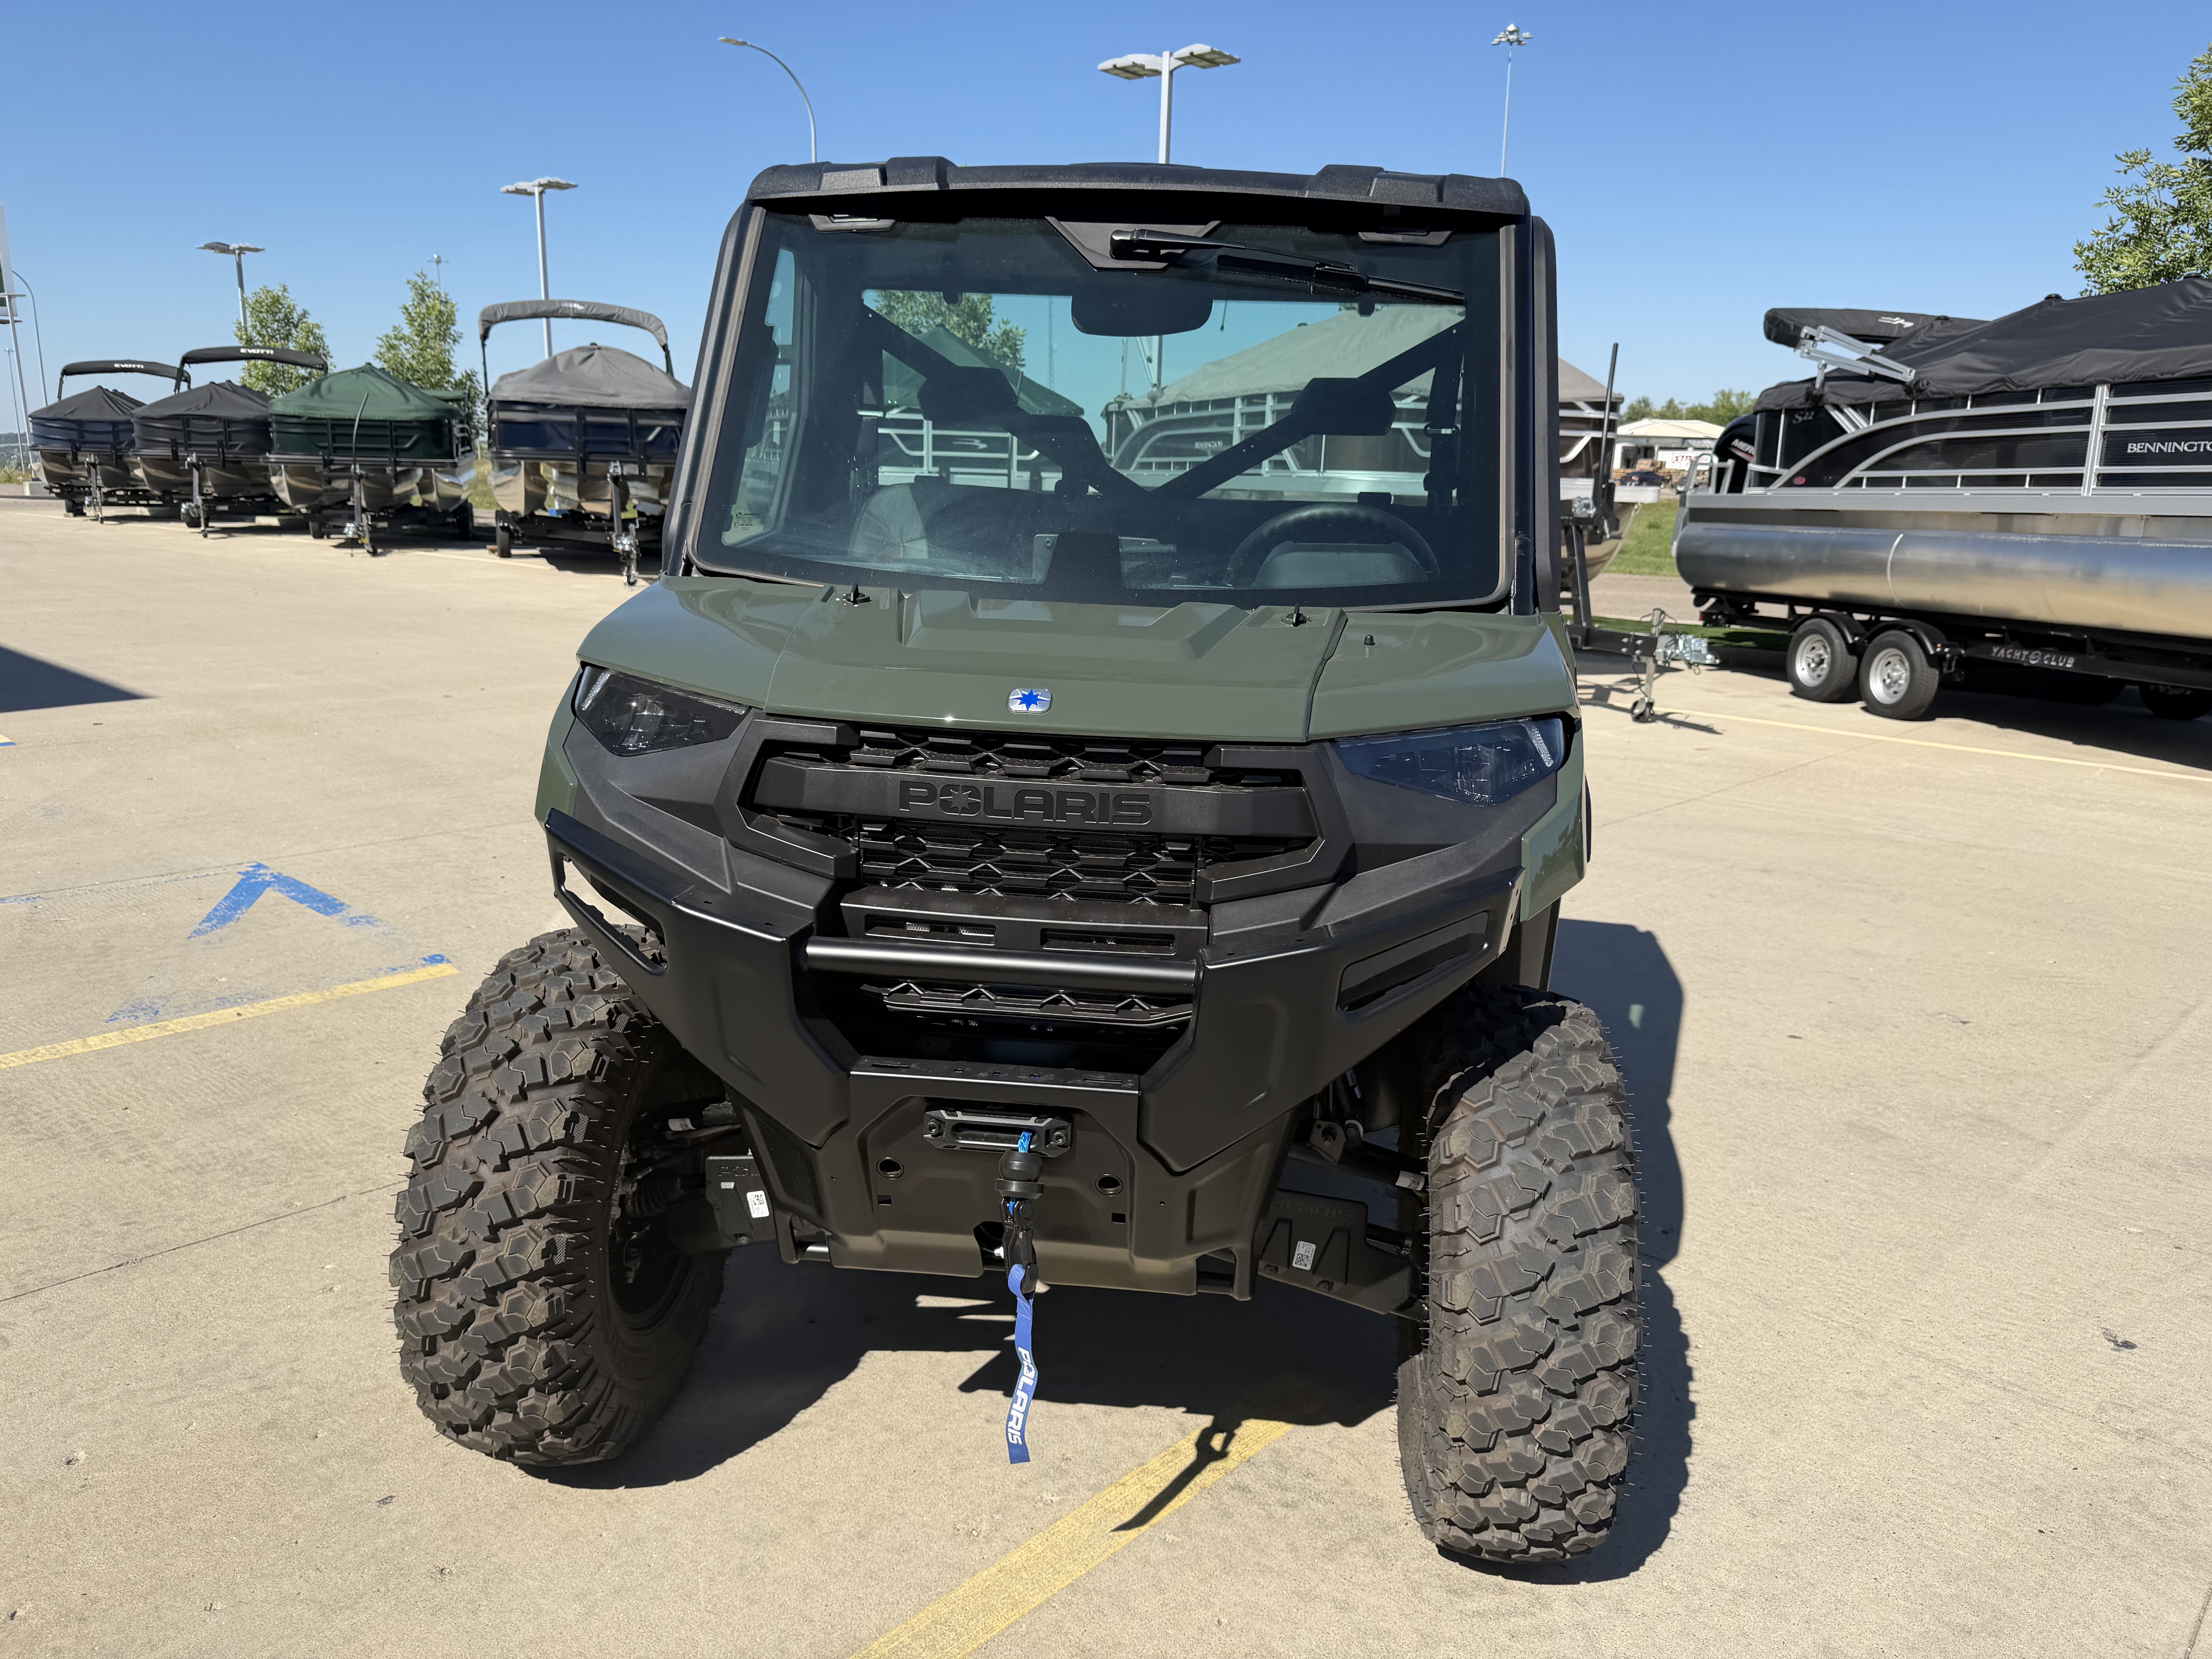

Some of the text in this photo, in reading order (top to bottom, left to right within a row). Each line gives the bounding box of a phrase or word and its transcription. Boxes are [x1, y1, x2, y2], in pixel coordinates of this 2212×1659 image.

[1992, 646, 2075, 668] YACHT CLUB
[899, 780, 1152, 825] POLARIS
[1270, 1200, 1352, 1221] OLARIS
[1008, 1346, 1035, 1445] POLARIS
